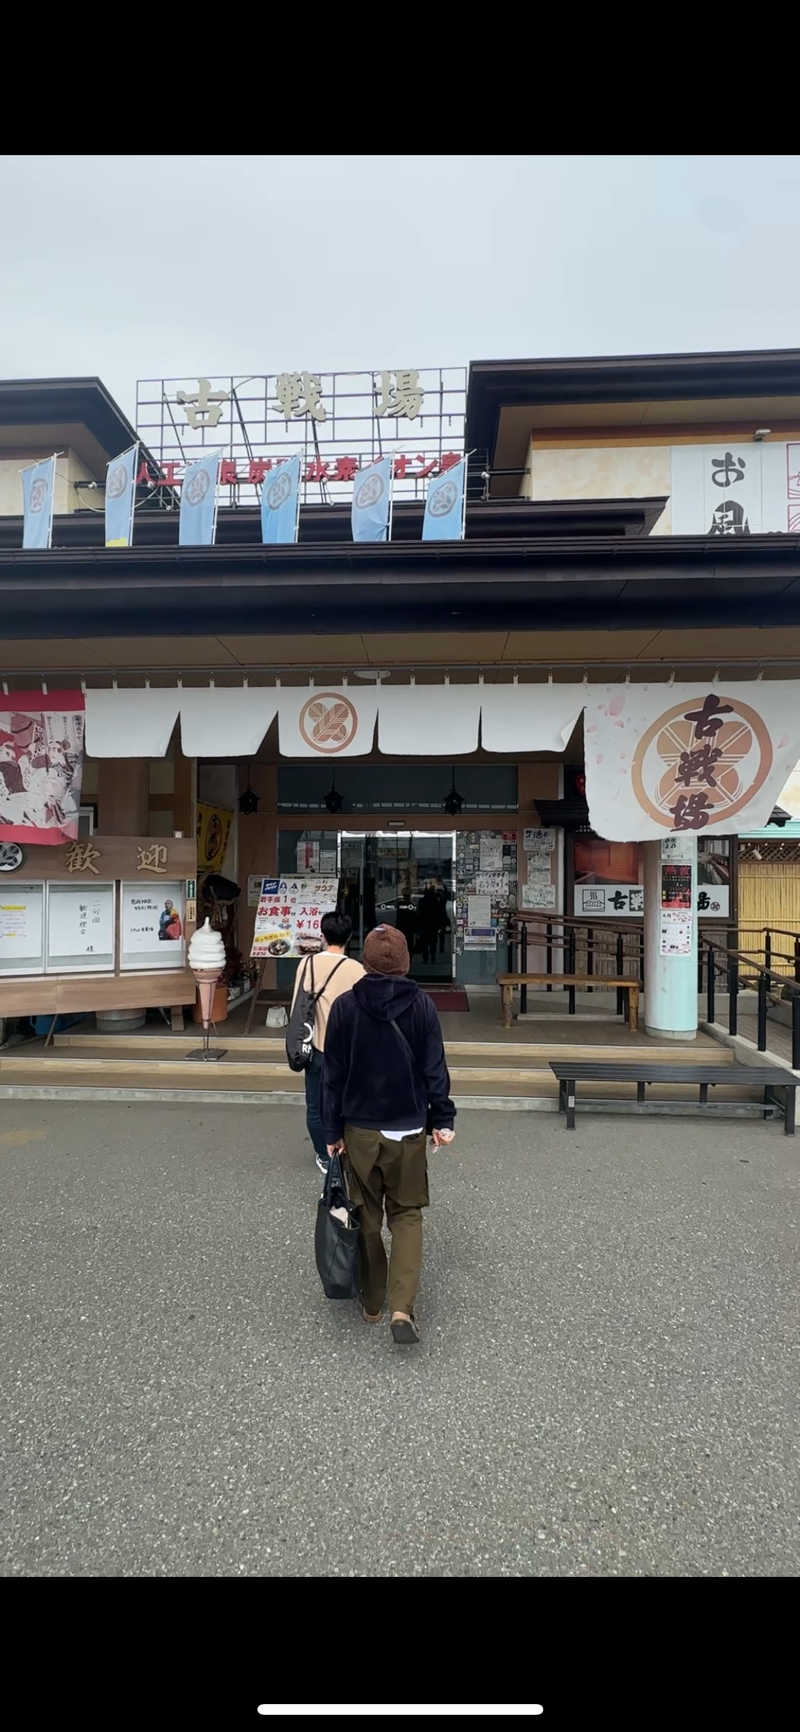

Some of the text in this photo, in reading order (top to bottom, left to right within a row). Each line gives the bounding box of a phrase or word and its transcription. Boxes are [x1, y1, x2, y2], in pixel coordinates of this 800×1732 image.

[669, 694, 734, 831] 古戦場
[65, 842, 168, 874] 歓迎
